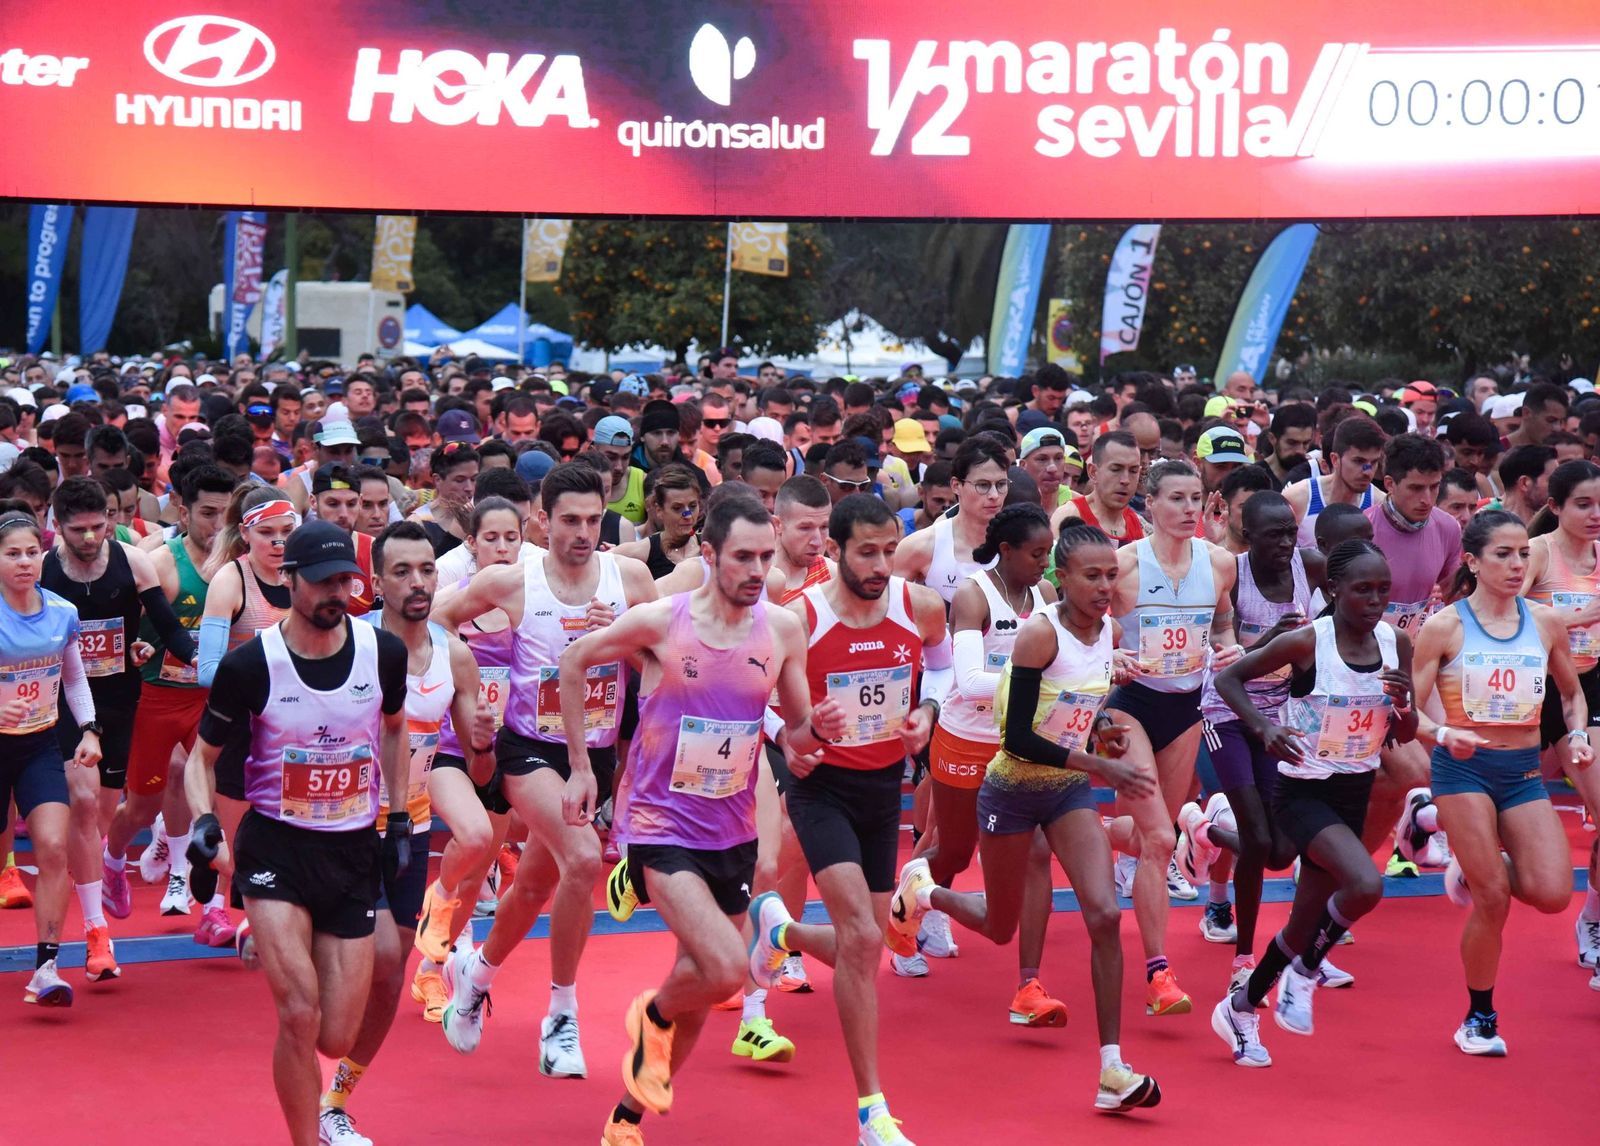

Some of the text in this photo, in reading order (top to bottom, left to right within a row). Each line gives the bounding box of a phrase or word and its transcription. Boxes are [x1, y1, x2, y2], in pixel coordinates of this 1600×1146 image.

[950, 28, 1289, 97] maratón
[347, 48, 599, 128] HOKA
[116, 93, 302, 131] HYUNDAI
[1369, 78, 1600, 127] 00:00:0
[1034, 85, 1290, 158] sevilla
[617, 115, 825, 156] quirónsalud
[29, 280, 47, 302] to
[1119, 237, 1154, 345] CAJÓN 1
[1397, 613, 1416, 629] 67
[1162, 628, 1187, 650] 39
[17, 681, 40, 701] 98
[1488, 668, 1515, 692] 40
[859, 684, 885, 707] 65
[858, 714, 882, 722] Simon
[1066, 708, 1093, 732] 33
[1347, 709, 1374, 732] 34
[717, 737, 732, 760] 4
[697, 765, 737, 775] Emmanuel
[938, 757, 978, 776] INEOS
[308, 768, 351, 791] 579
